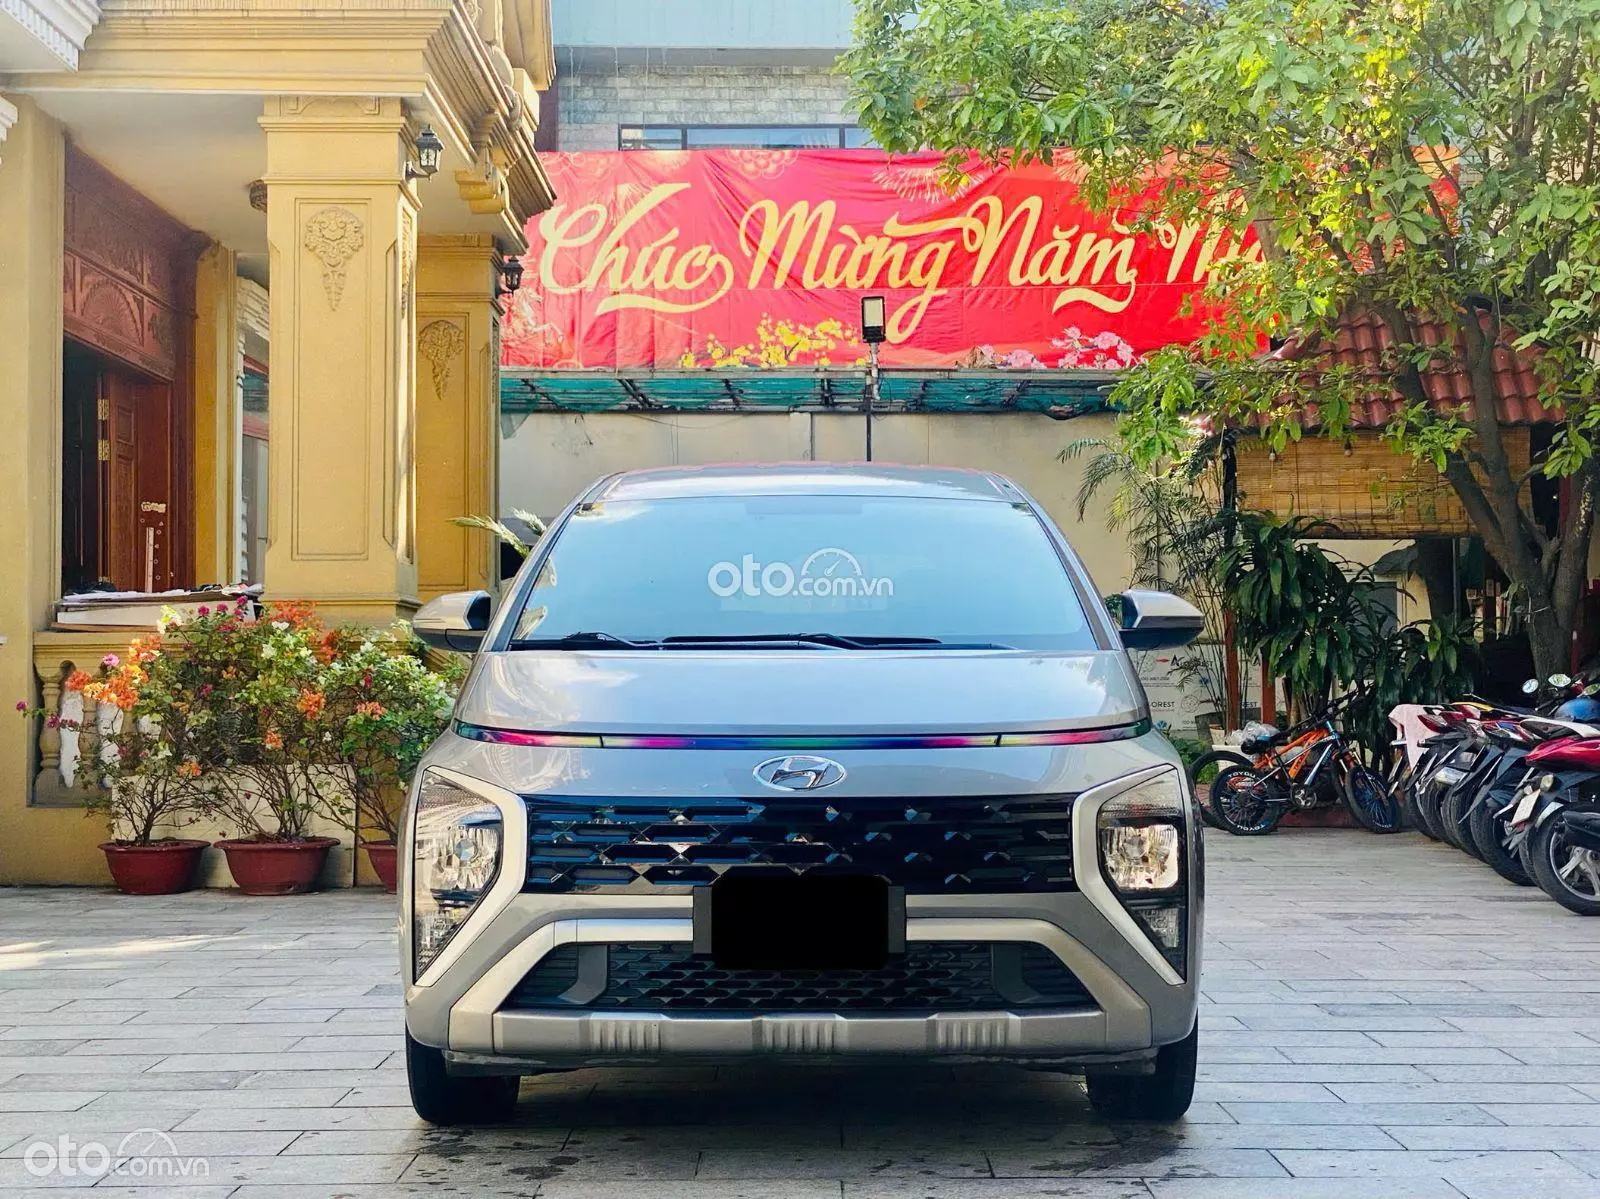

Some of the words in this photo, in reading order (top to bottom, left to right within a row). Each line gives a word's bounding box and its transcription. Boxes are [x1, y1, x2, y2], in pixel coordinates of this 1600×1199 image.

[539, 182, 735, 315] Chúc
[739, 200, 956, 344] Mừng
[883, 195, 1138, 315] Năm
